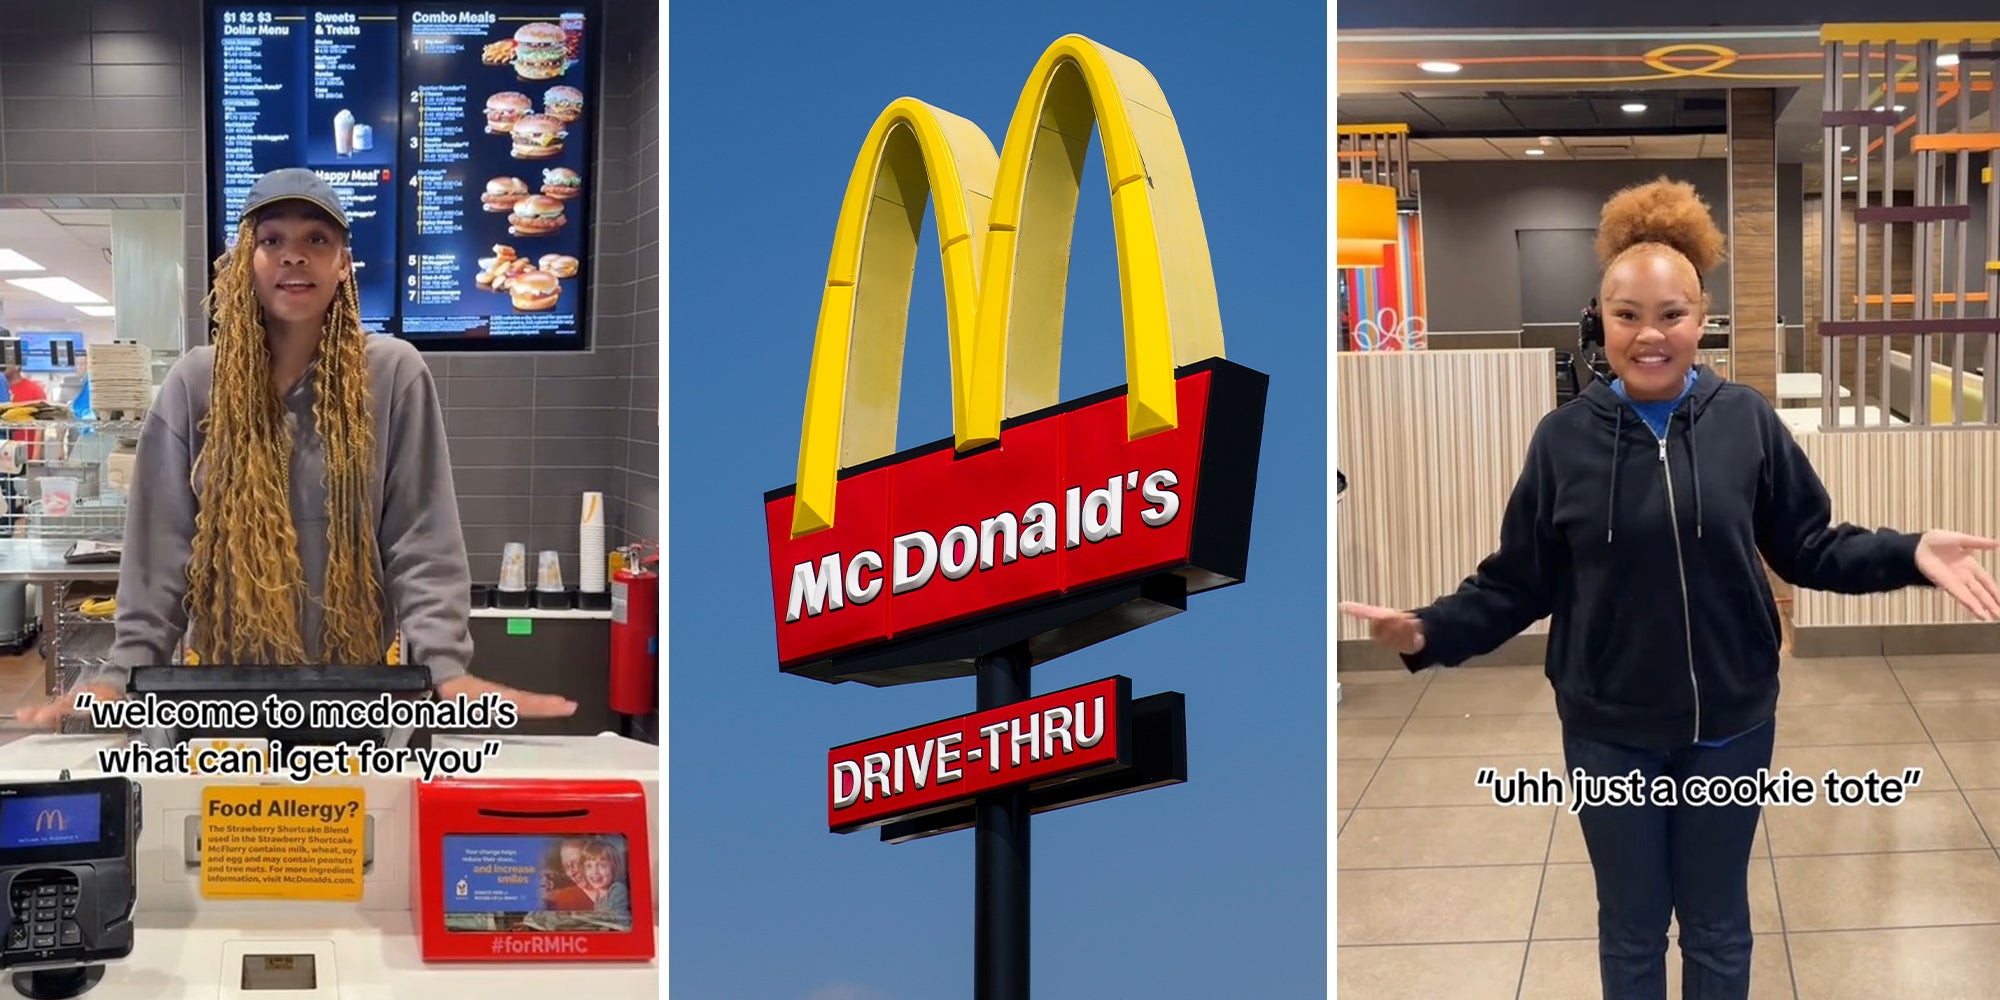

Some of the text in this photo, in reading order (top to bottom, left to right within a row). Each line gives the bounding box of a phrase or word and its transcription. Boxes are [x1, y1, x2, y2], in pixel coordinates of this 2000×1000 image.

[224, 11, 272, 23] $1 $2 $3
[315, 12, 356, 23] Sweets
[412, 11, 496, 23] Combo Meals
[224, 24, 289, 35] Dollar Menu
[315, 24, 360, 35] & Treats
[412, 40, 419, 50] 1
[410, 91, 418, 102] 2
[410, 137, 418, 148] 3
[315, 170, 350, 182] Happy
[409, 176, 418, 187] 4
[408, 255, 417, 266] 5
[408, 275, 416, 286] 6
[408, 290, 417, 301] 7
[785, 468, 1181, 623] McDonald's
[832, 696, 1105, 809] DRIVE-THRU
[208, 800, 360, 823] Food Allergy?
[226, 826, 276, 834] Strawberry
[277, 826, 322, 834] Shortcake
[324, 826, 349, 834] Blend
[208, 834, 353, 846] used in the Strawberry Shortcake
[208, 845, 357, 856] McFlurry contains milk, wheat, soy
[208, 855, 224, 863] and
[226, 856, 242, 864] egg
[263, 857, 281, 865] may
[283, 856, 316, 864] contain
[317, 856, 353, 865] peanuts
[309, 866, 354, 875] ingredient
[473, 864, 536, 874] and increase
[208, 875, 261, 884] information,
[283, 876, 356, 884] McDonalds.com.
[498, 875, 529, 884] smiles
[491, 936, 588, 954] #forRMHC
